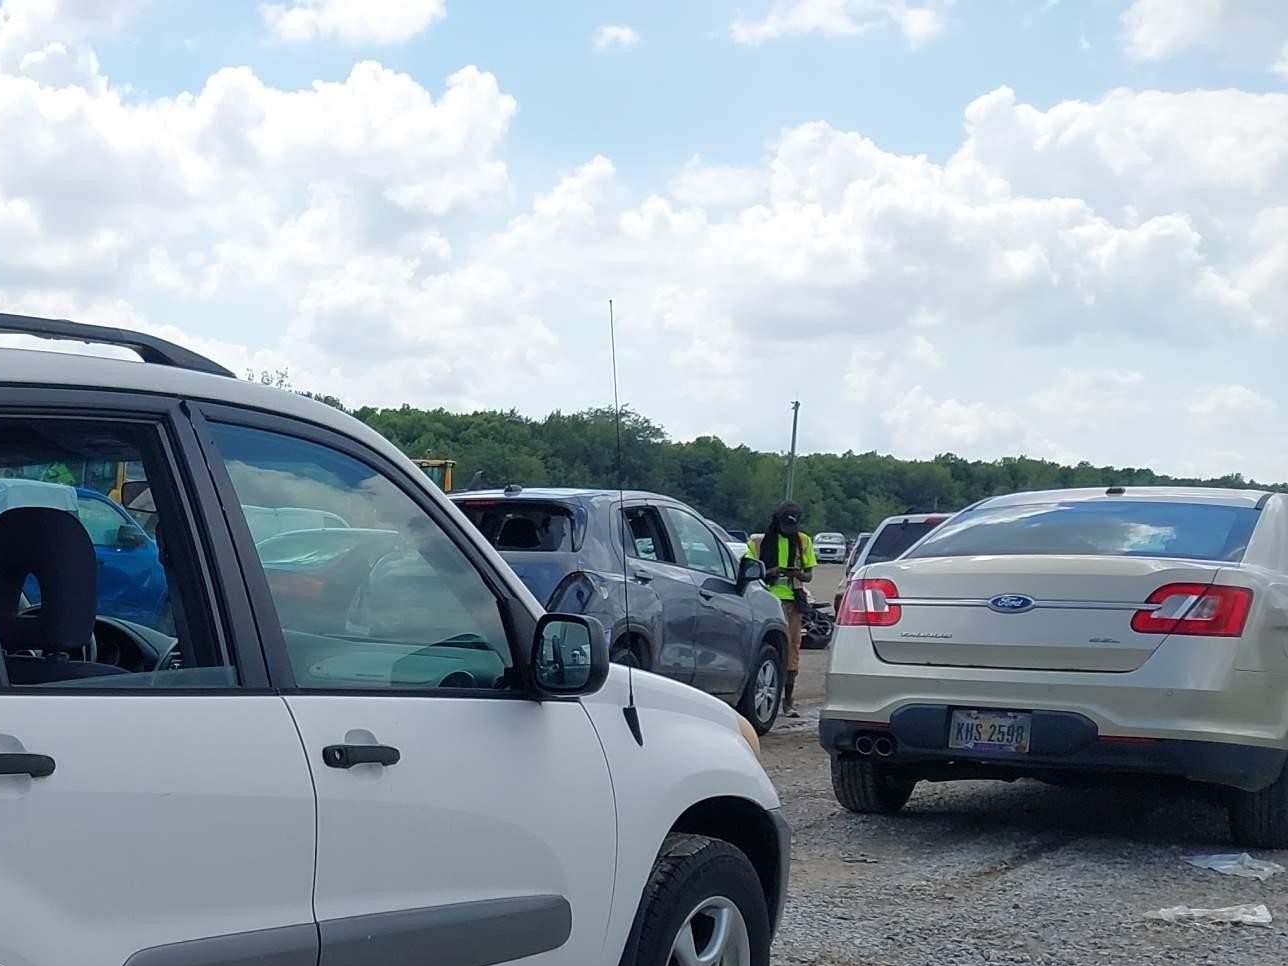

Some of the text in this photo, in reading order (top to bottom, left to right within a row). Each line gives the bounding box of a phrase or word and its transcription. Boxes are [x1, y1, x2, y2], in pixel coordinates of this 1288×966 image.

[997, 595, 1024, 608] Ford
[956, 722, 1025, 744] KHS 2598
